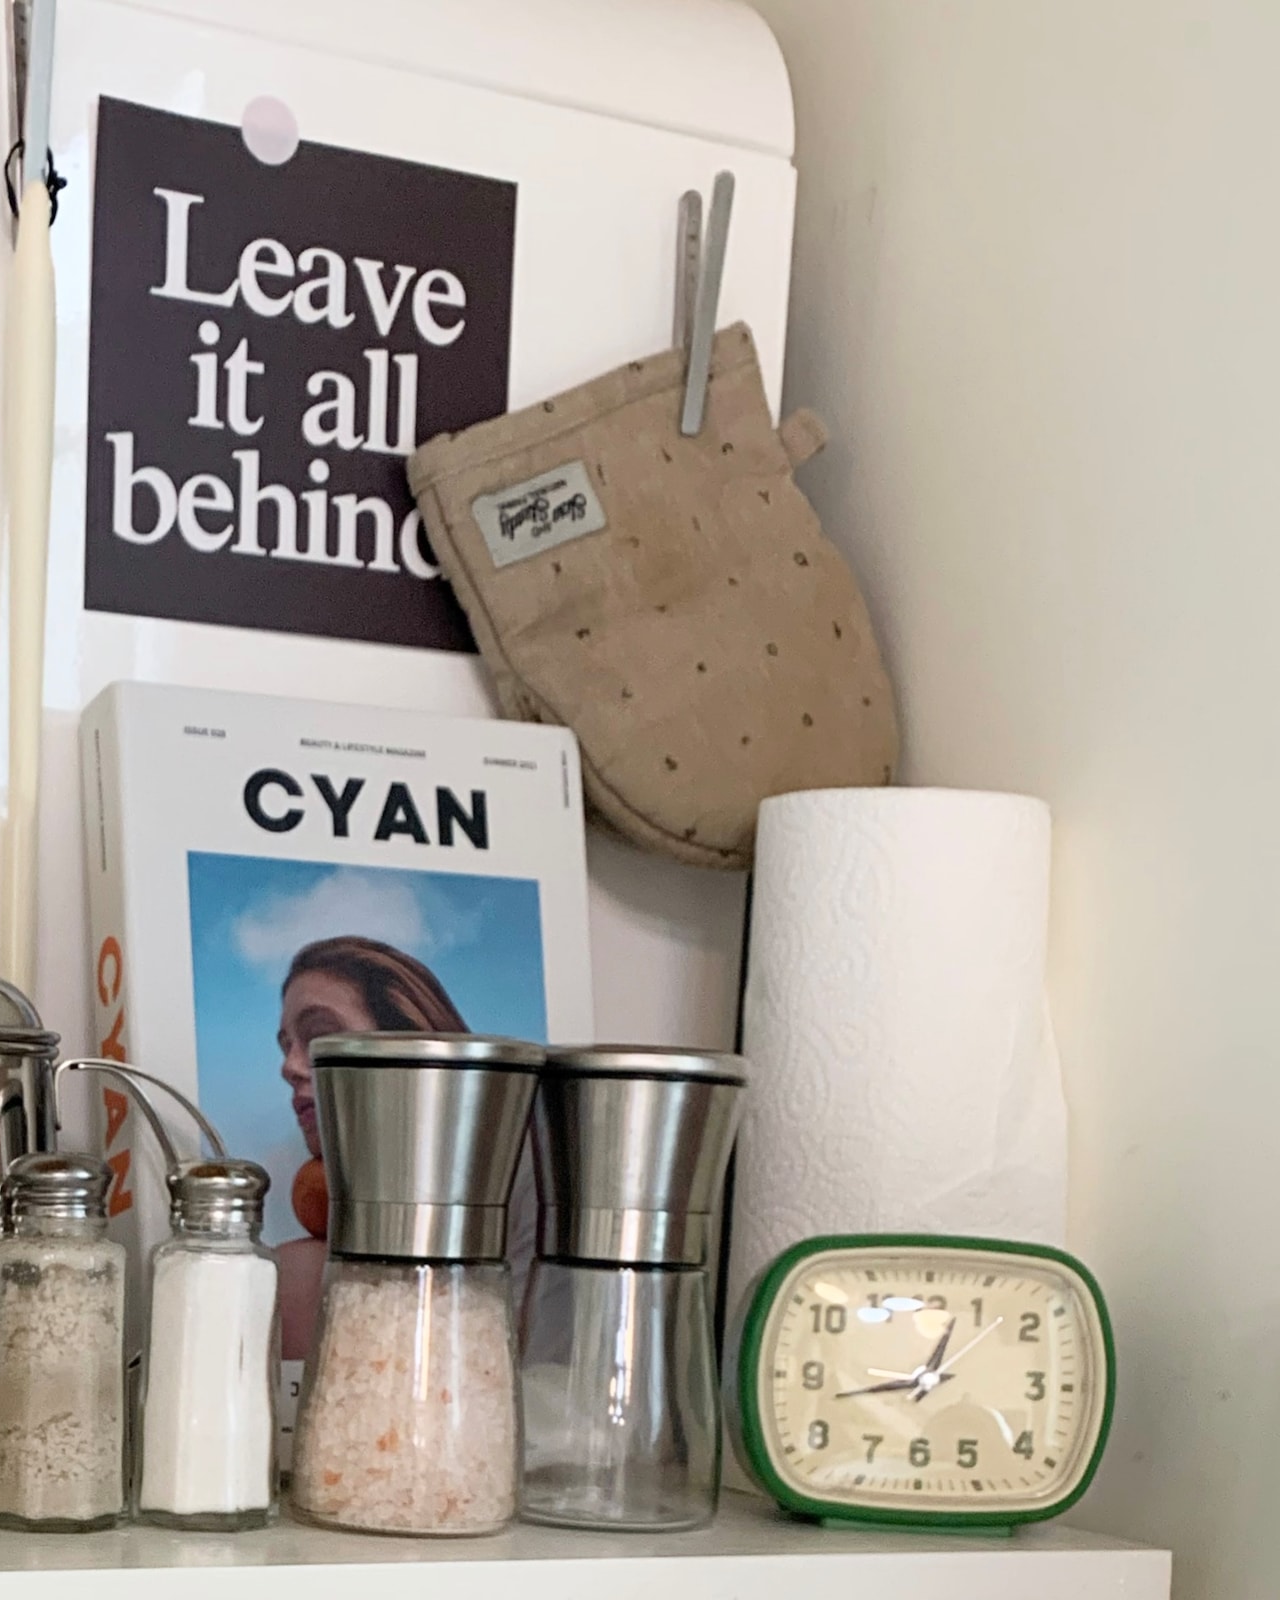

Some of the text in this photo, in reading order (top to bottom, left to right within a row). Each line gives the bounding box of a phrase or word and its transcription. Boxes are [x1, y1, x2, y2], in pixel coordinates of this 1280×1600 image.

[149, 186, 467, 347] Leave
[187, 319, 419, 456] it all
[243, 767, 490, 851] CYAN
[96, 935, 134, 1219] CYAN
[809, 1303, 847, 1335] 10
[970, 1298, 983, 1327] 1
[1018, 1312, 1041, 1342] 2
[801, 1360, 825, 1390] 9
[1024, 1371, 1046, 1400] 3
[808, 1420, 830, 1450] 8
[862, 1434, 884, 1463] 7
[1012, 1430, 1035, 1460] 4
[908, 1438, 931, 1467] 6
[956, 1438, 979, 1468] 5
